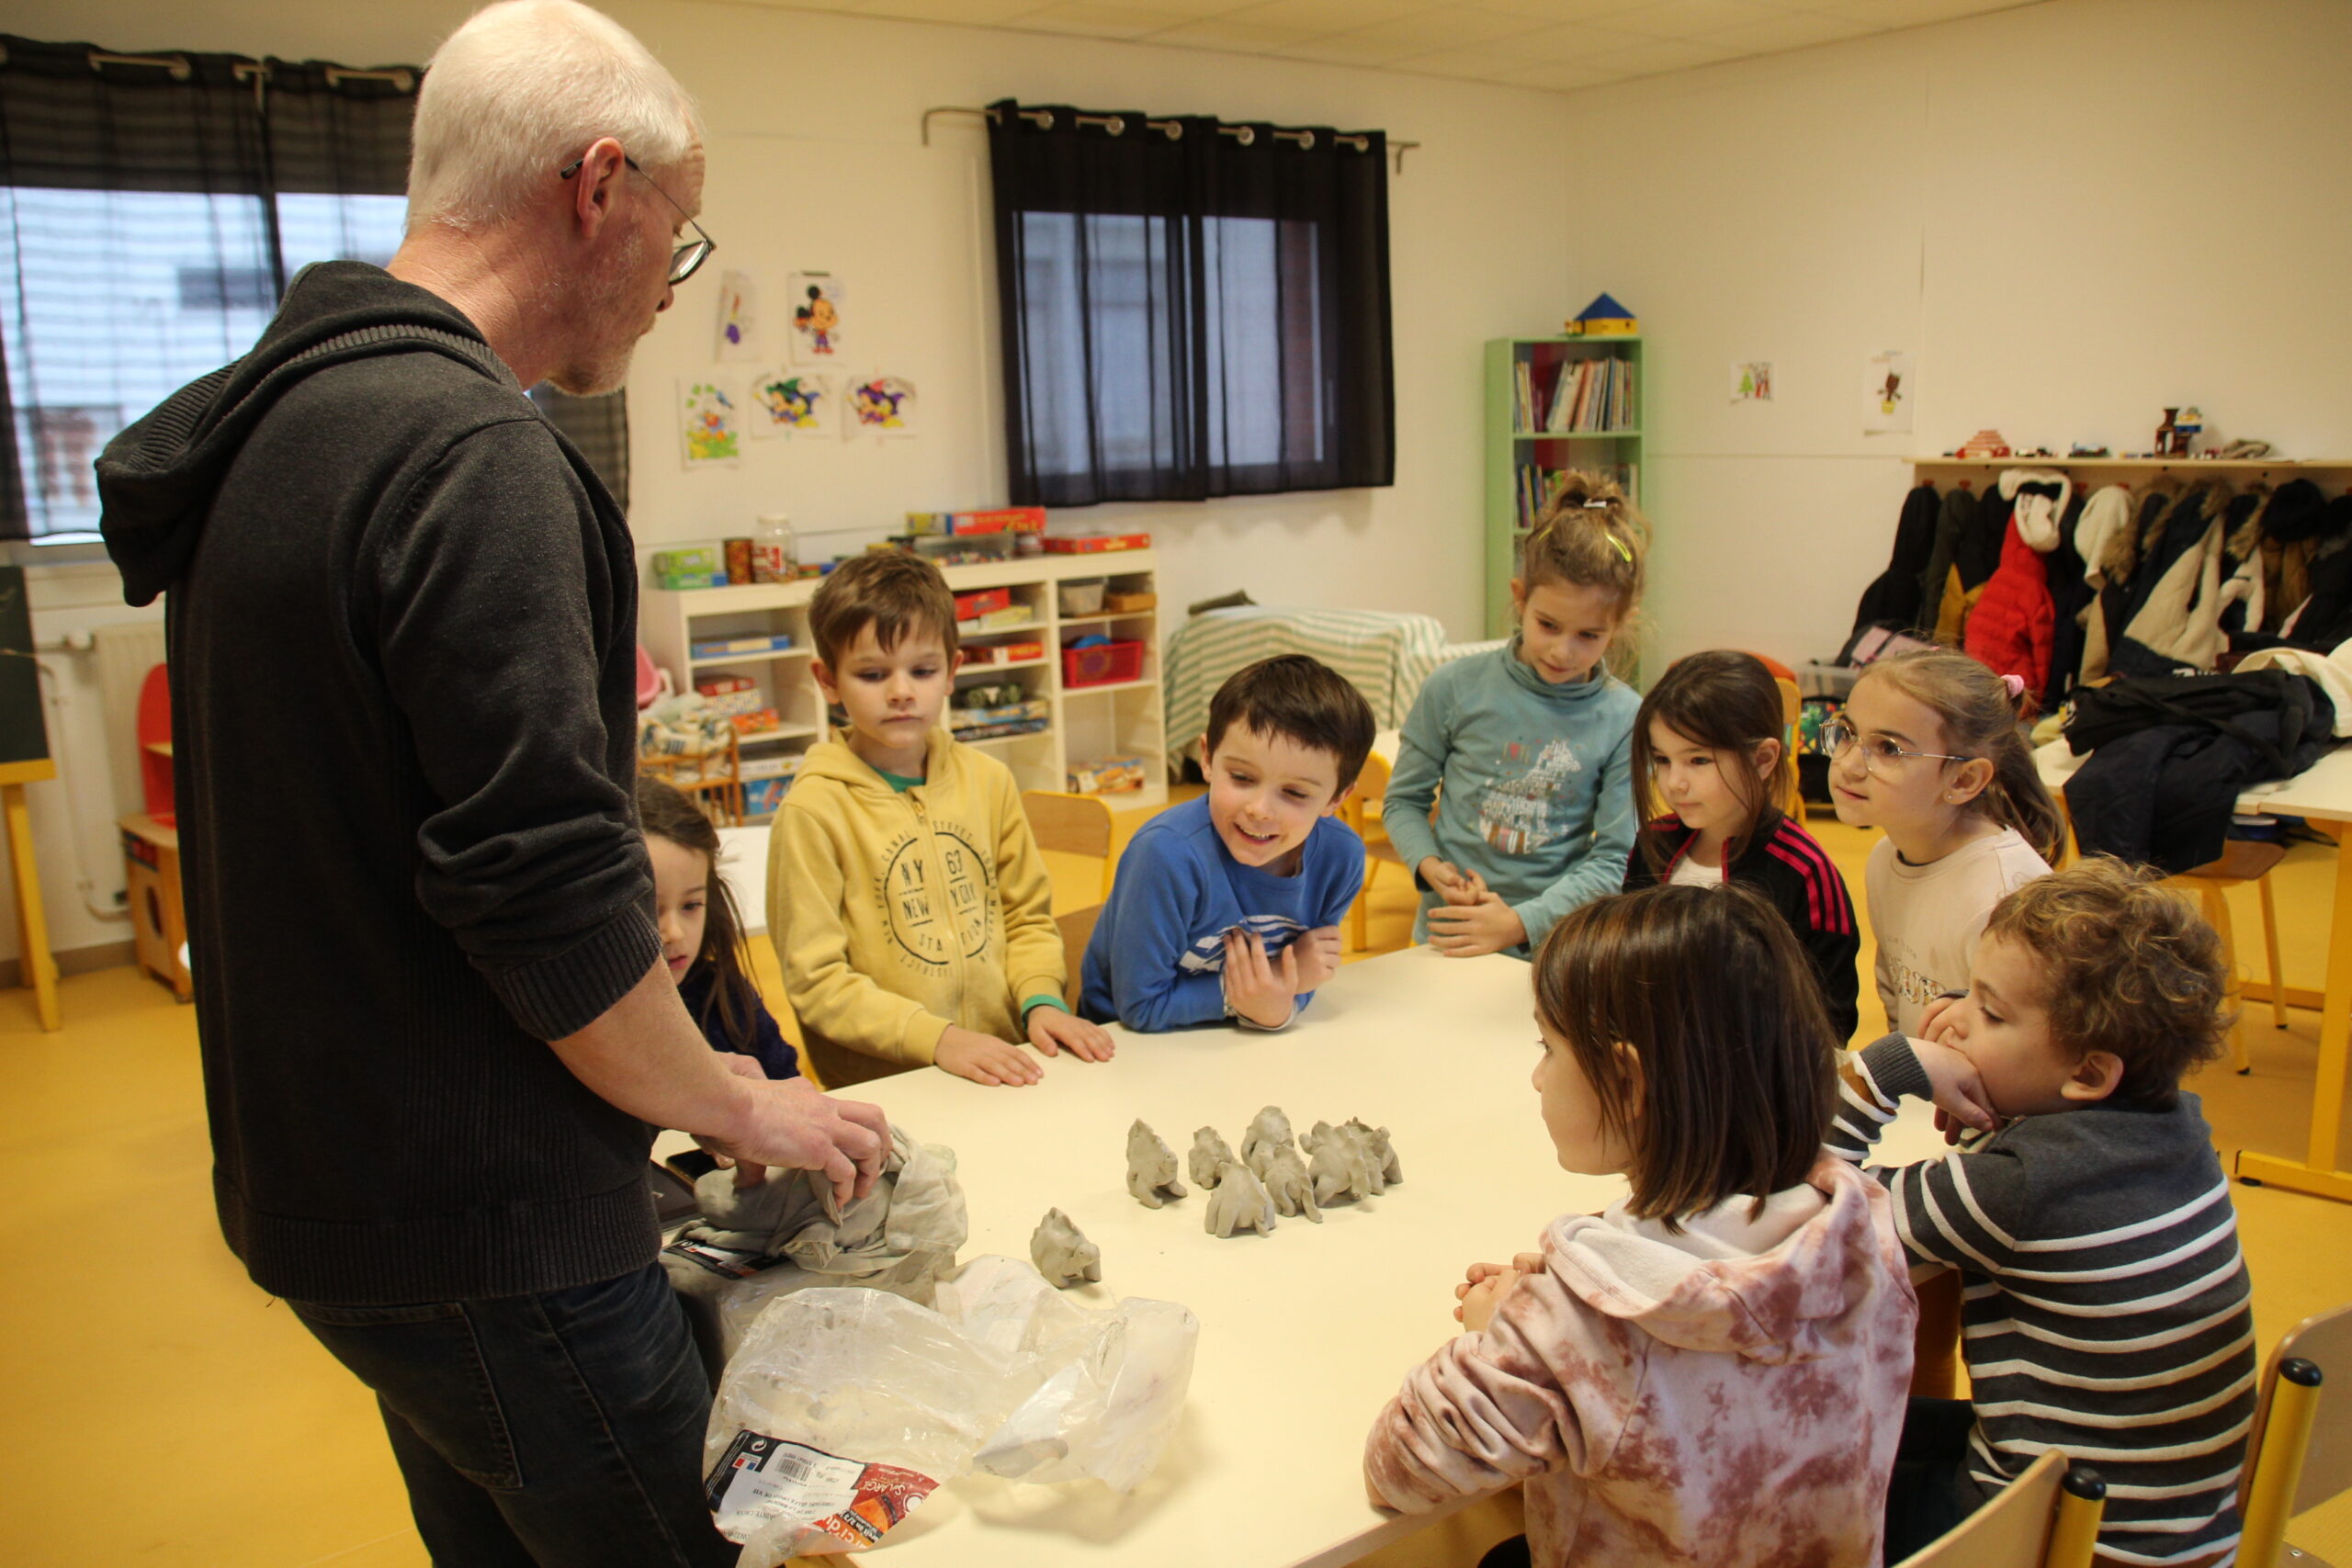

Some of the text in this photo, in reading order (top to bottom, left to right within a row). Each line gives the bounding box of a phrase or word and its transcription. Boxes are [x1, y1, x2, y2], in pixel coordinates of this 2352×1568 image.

[881, 829, 910, 862] CANAL
[945, 849, 963, 874] 63
[902, 896, 931, 920] NEW
